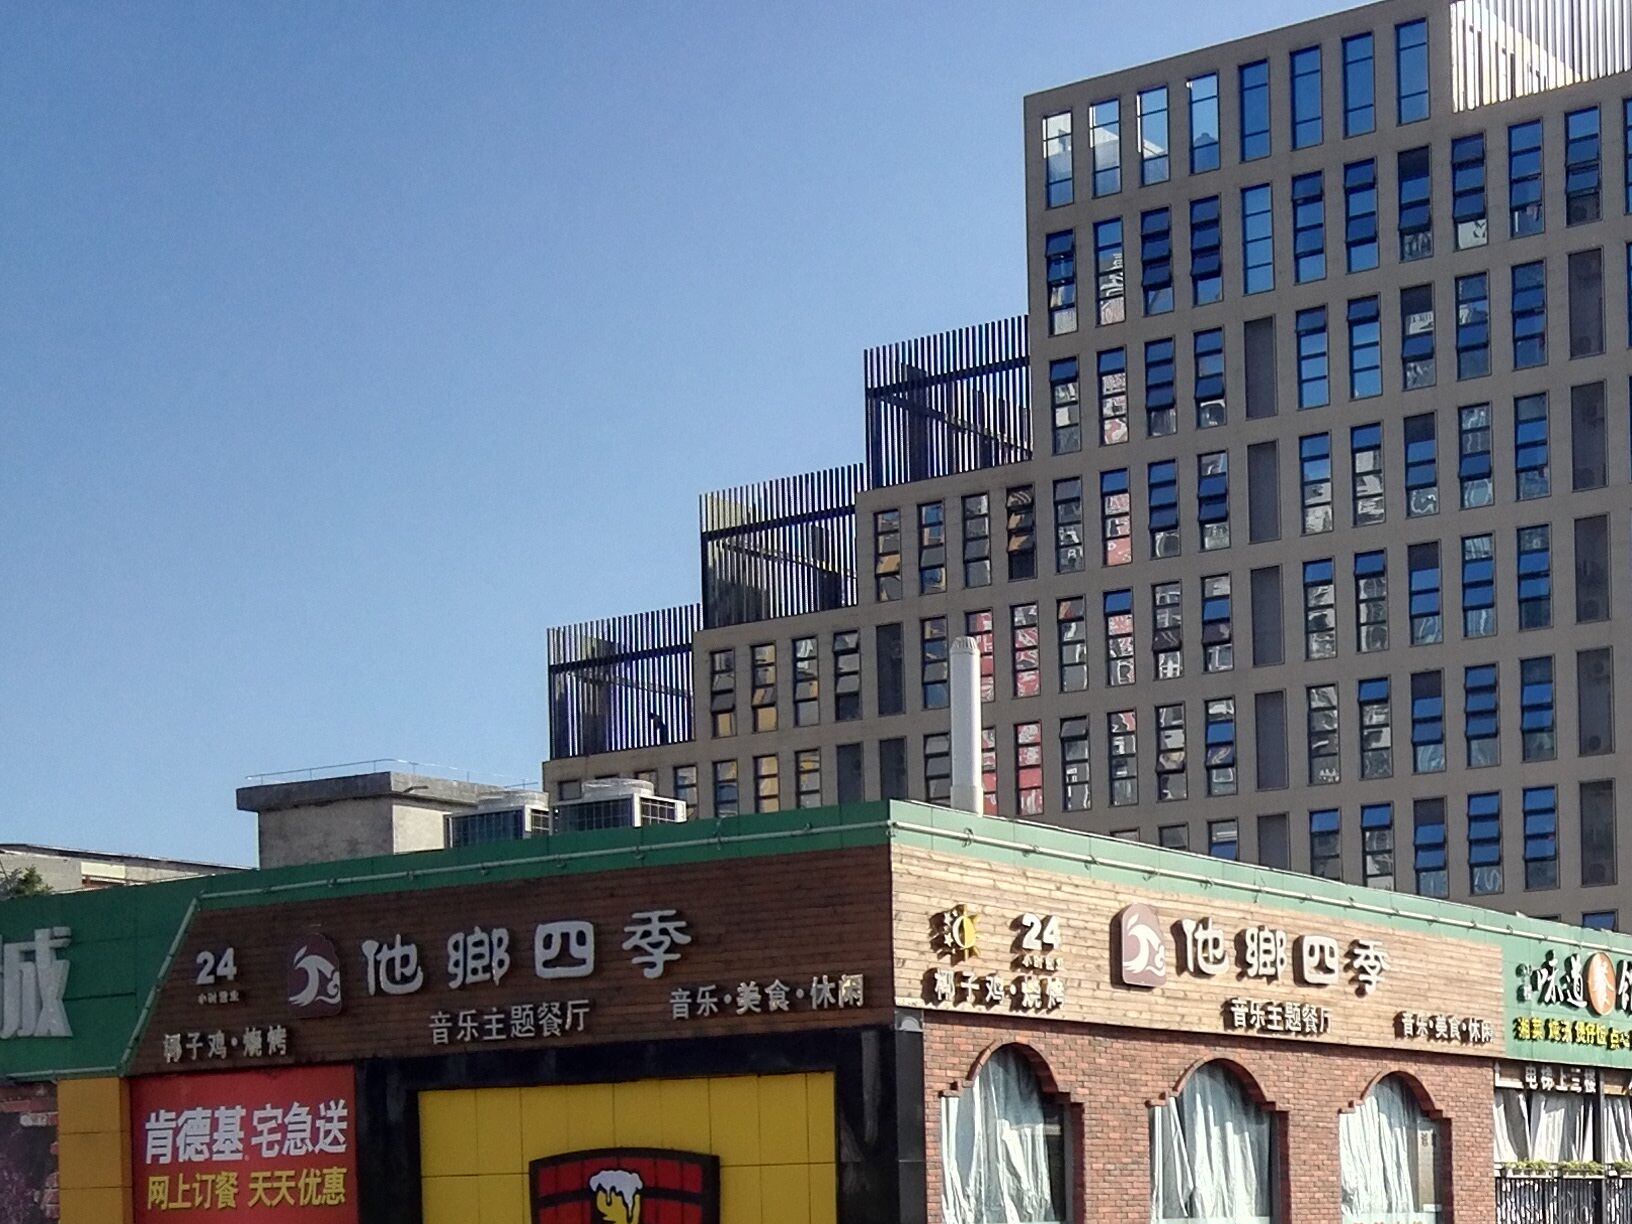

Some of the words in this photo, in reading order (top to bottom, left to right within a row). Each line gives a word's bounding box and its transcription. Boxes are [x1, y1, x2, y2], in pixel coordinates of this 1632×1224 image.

[1022, 912, 1062, 951] 24
[196, 947, 238, 985] 24
[429, 1000, 591, 1045] 音乐主题餐厅
[1231, 998, 1333, 1035] 音乐主题餐厅
[1525, 1066, 1597, 1094] 电梯上三楼
[147, 1171, 238, 1211] 网上订餐
[248, 1166, 347, 1208] 天天优惠
